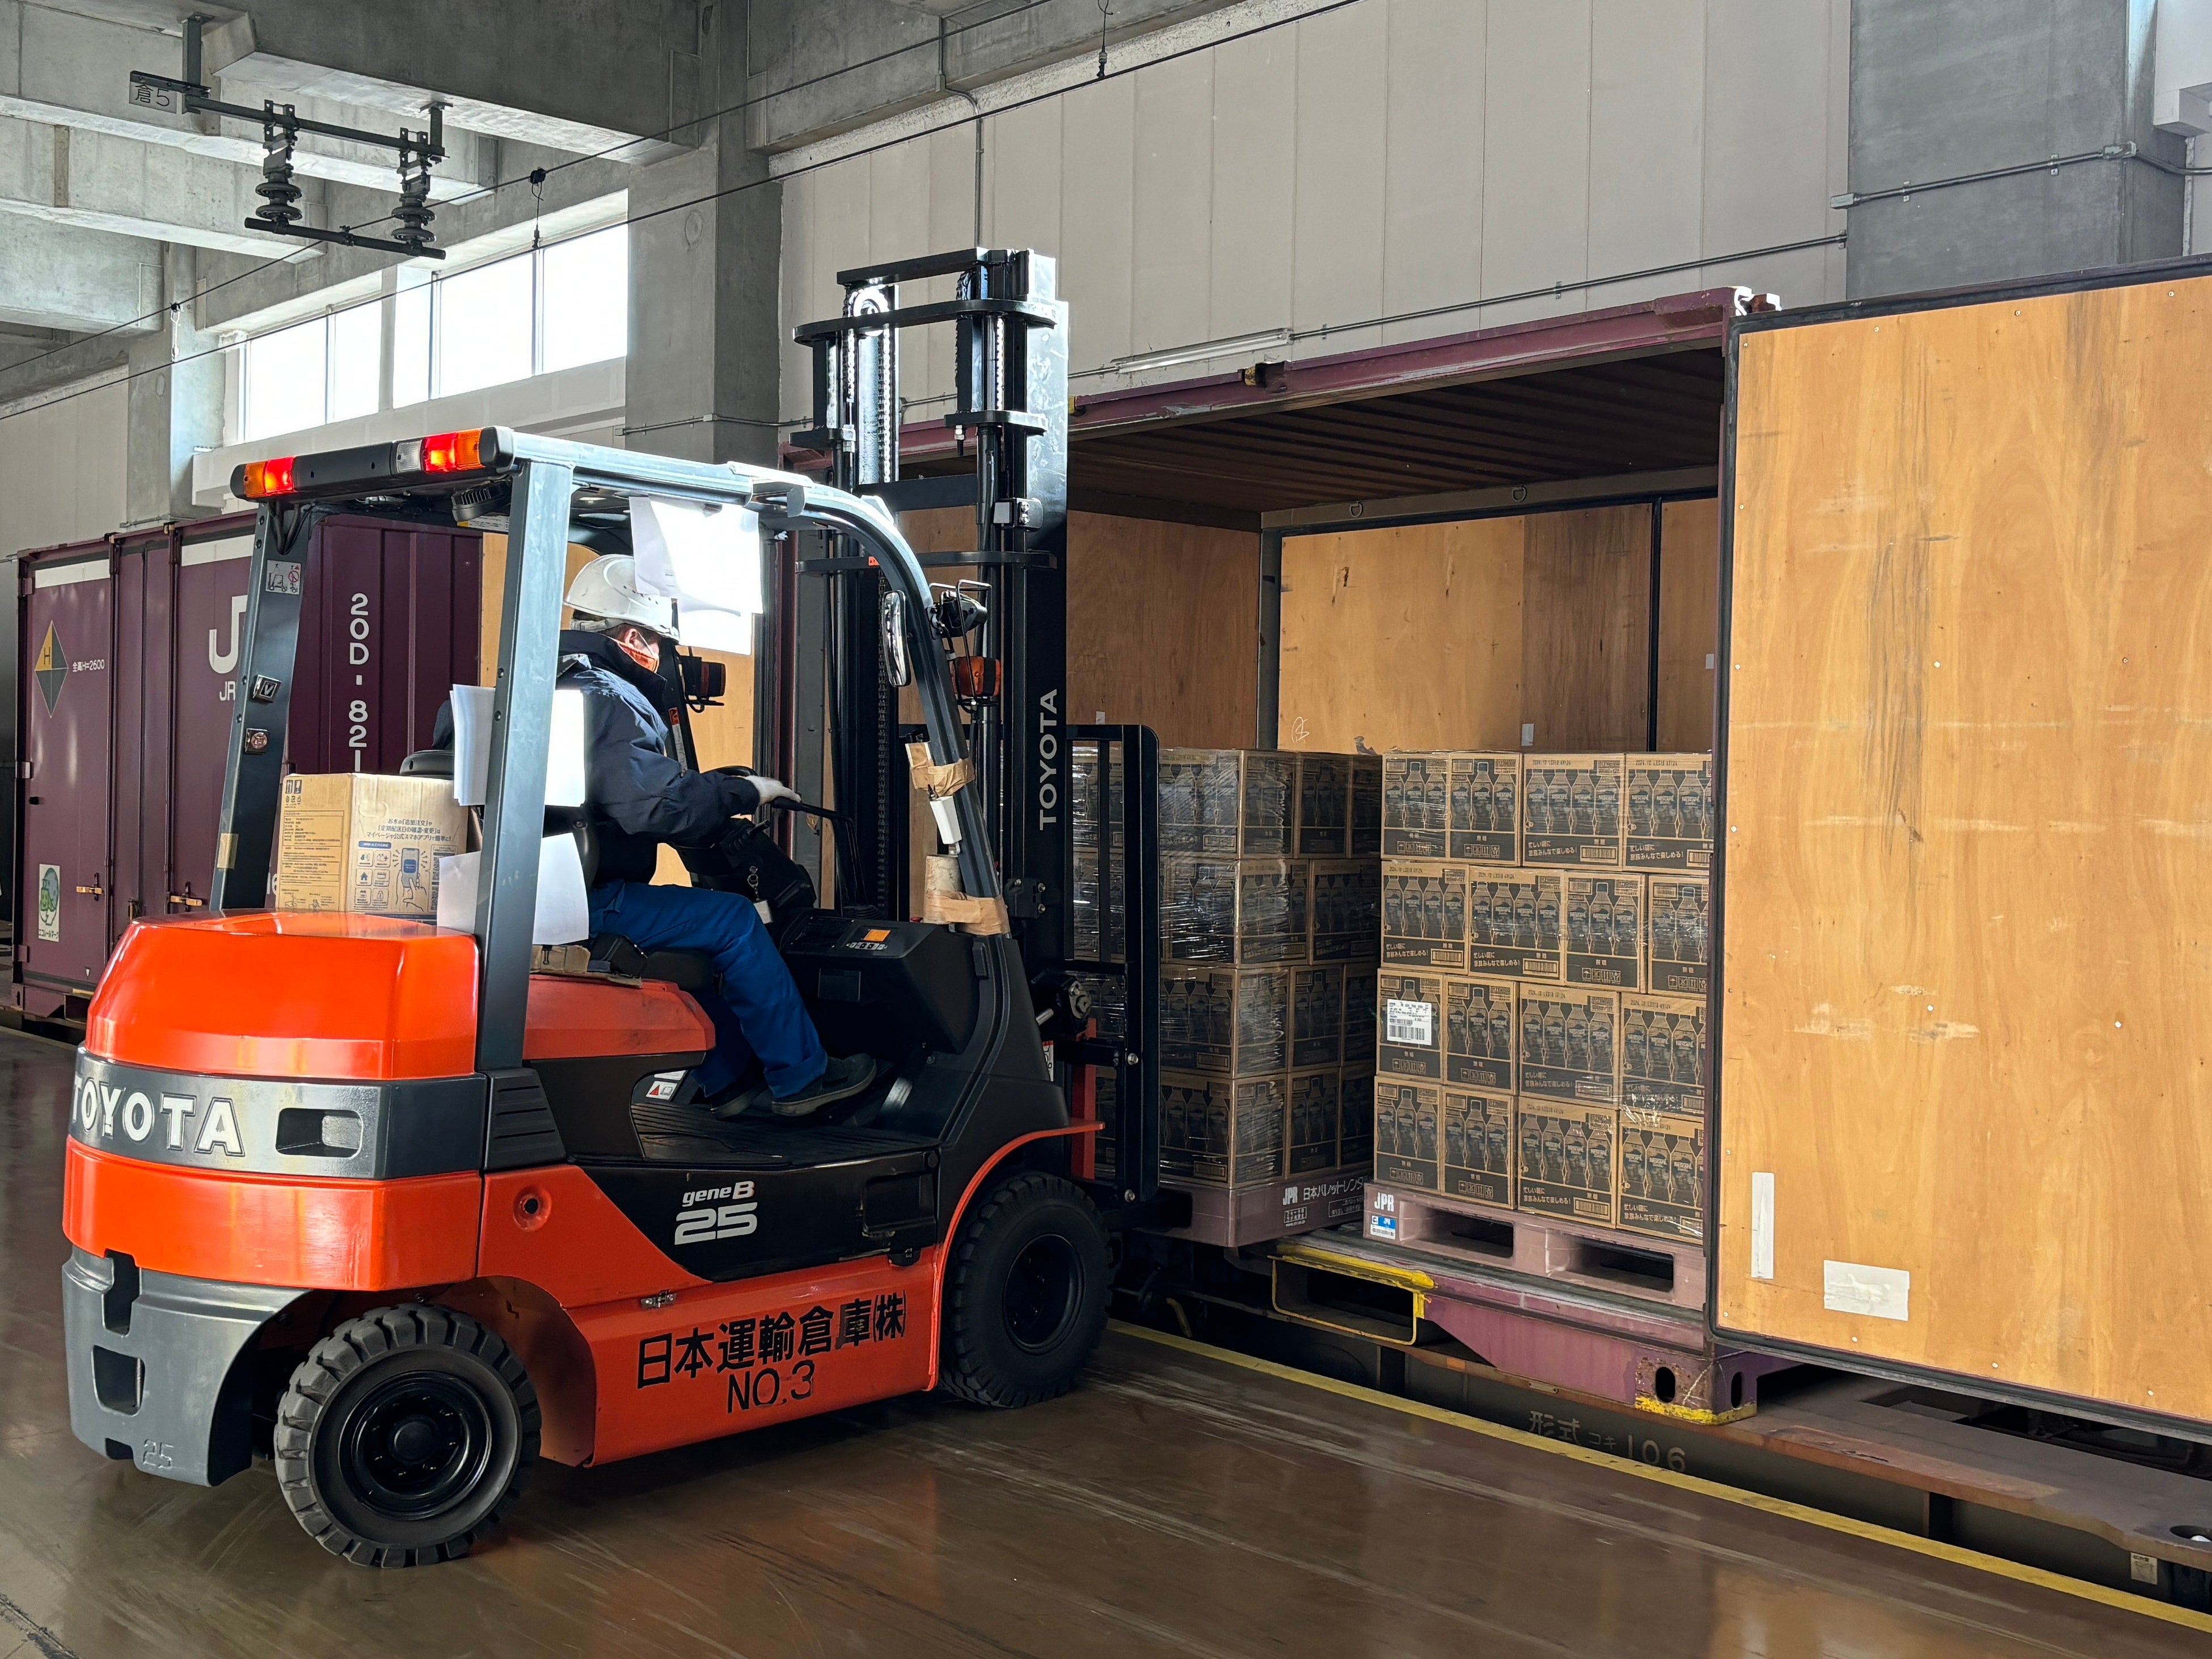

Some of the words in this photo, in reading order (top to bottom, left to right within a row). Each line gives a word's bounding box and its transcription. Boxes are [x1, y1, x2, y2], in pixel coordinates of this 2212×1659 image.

[134, 85, 170, 107] 倉5
[44, 647, 51, 665] H
[72, 659, 105, 672] 全高H=2600
[1039, 689, 1057, 831] TOYOTA
[1282, 1186, 1298, 1206] JPR
[1374, 1192, 1394, 1211] JPR
[674, 1202, 758, 1246] 25
[727, 1360, 816, 1414] NO.3
[143, 1438, 174, 1469] 25
[1529, 1409, 1582, 1446] 形式
[1589, 1432, 1616, 1450] コキ
[1628, 1434, 1686, 1473] 106
